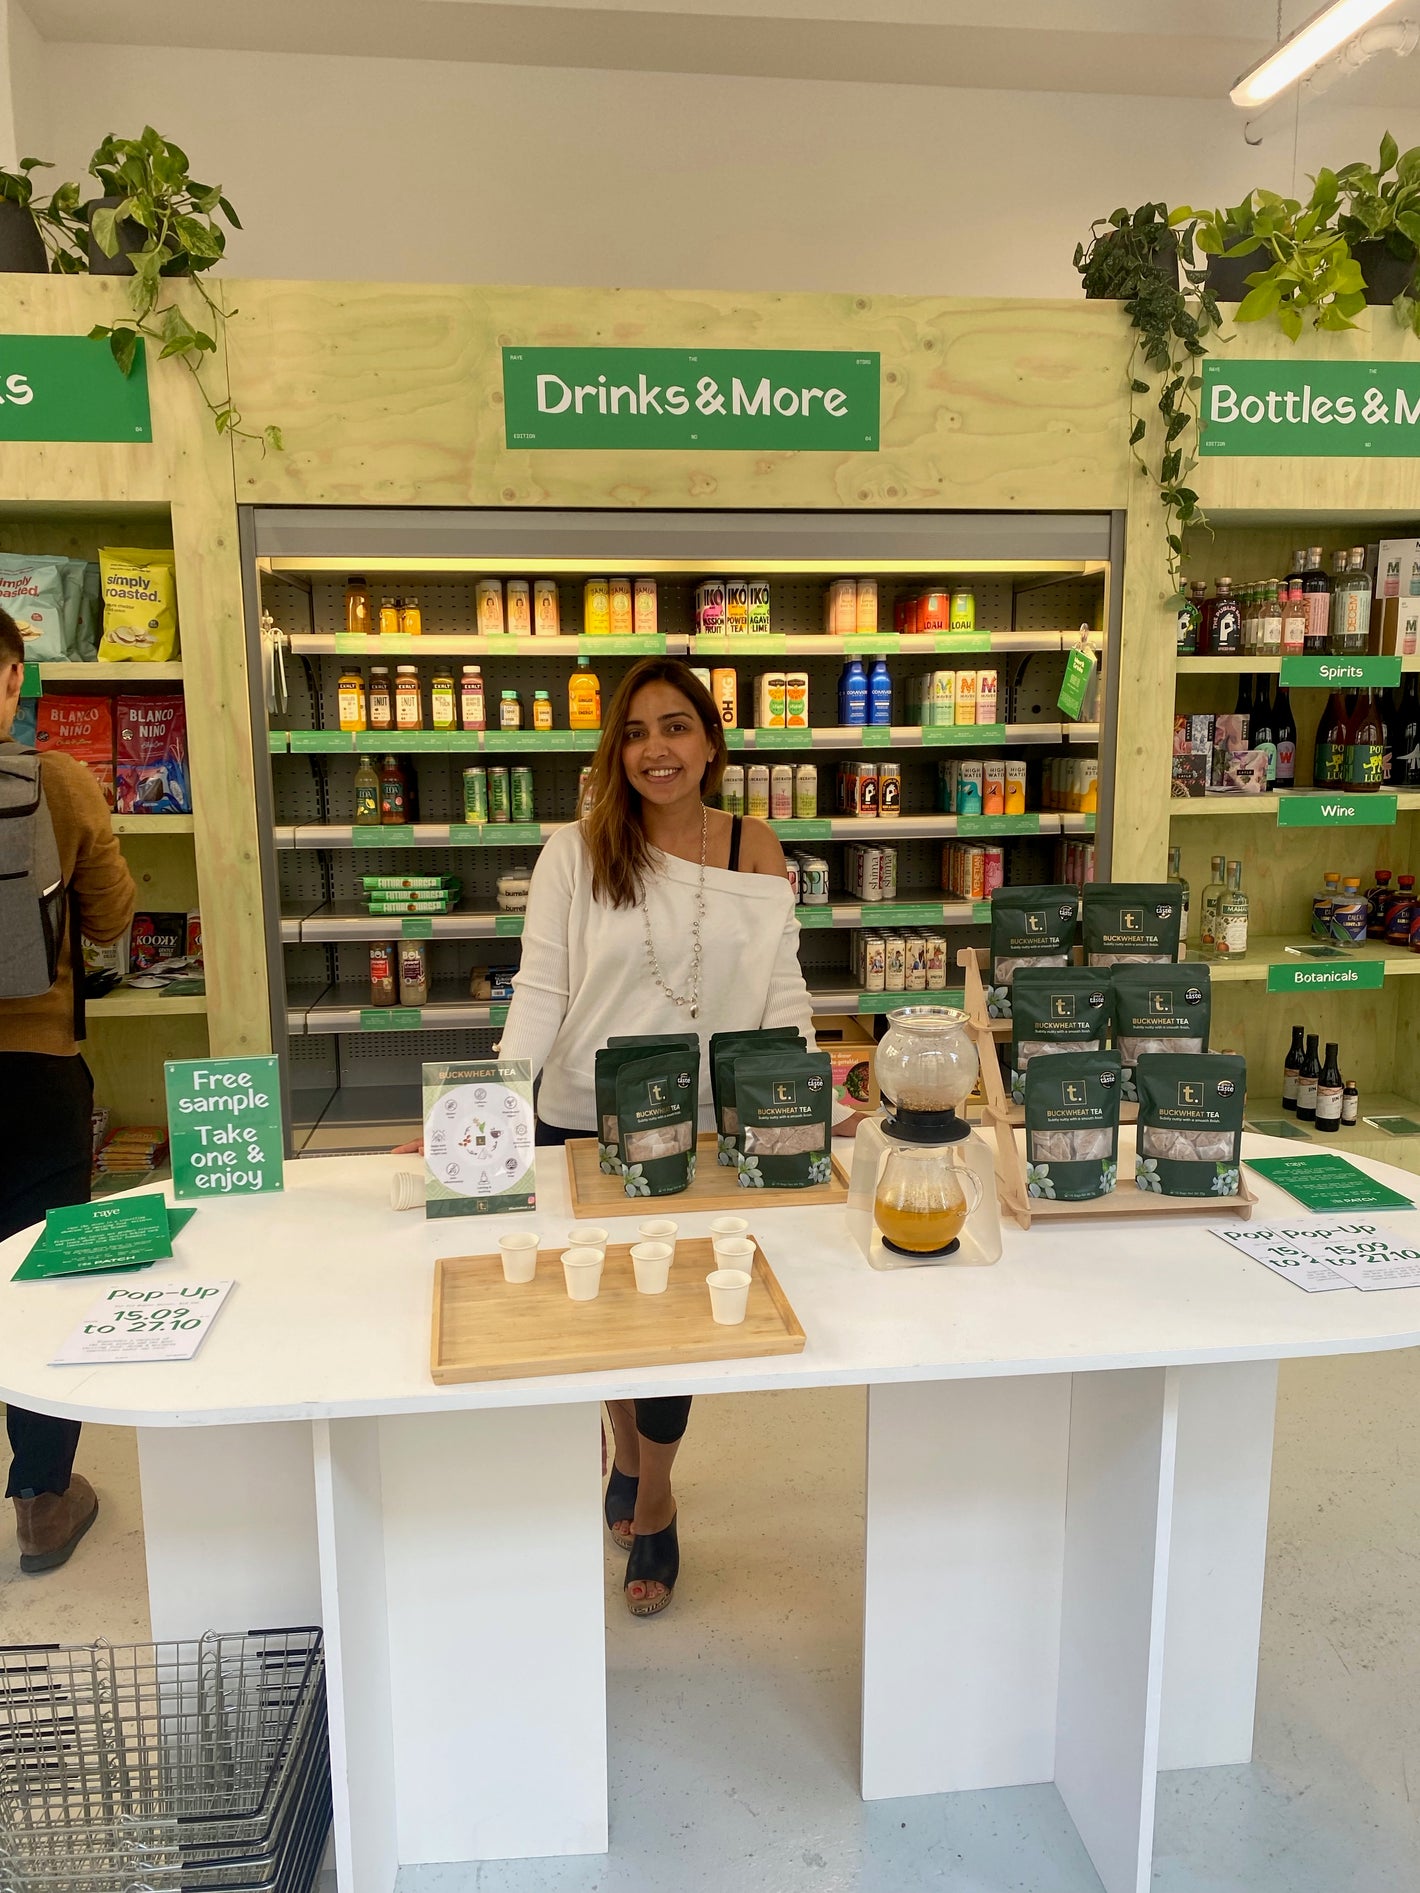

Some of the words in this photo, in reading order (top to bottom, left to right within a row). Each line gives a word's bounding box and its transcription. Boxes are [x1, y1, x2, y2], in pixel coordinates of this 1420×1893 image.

[107, 574, 150, 589] simply
[105, 588, 161, 603] roasted.
[1319, 665, 1363, 680] Spirits
[51, 708, 99, 722] BLANCO
[129, 709, 174, 722] BLANCO
[139, 723, 166, 737] NIÑO
[1321, 805, 1355, 817] Wine
[136, 935, 178, 946] KOOKY
[370, 951, 387, 959] BOL
[402, 951, 420, 959] BOL
[1294, 970, 1358, 984] Botanicals
[193, 1070, 253, 1090] Free
[439, 1069, 496, 1079] BUCKWHEAT
[179, 1089, 269, 1115] sample
[758, 1107, 798, 1115] BUCKWHEAT
[1159, 1109, 1204, 1117] BUCKWHEAT
[194, 1124, 258, 1145] Take
[190, 1151, 237, 1167] one
[246, 1144, 266, 1163] &
[195, 1167, 263, 1192] enjoy
[92, 1208, 121, 1218] raye
[1281, 1224, 1377, 1239] Pop-Up
[1324, 1242, 1389, 1255] 15.09
[94, 1255, 135, 1265] PATCH
[1269, 1259, 1300, 1268] to
[1325, 1258, 1357, 1267] to
[106, 1286, 220, 1301] Pop-Up
[113, 1309, 191, 1321] 15.09
[83, 1324, 116, 1334] to
[127, 1319, 202, 1333] 27.10
